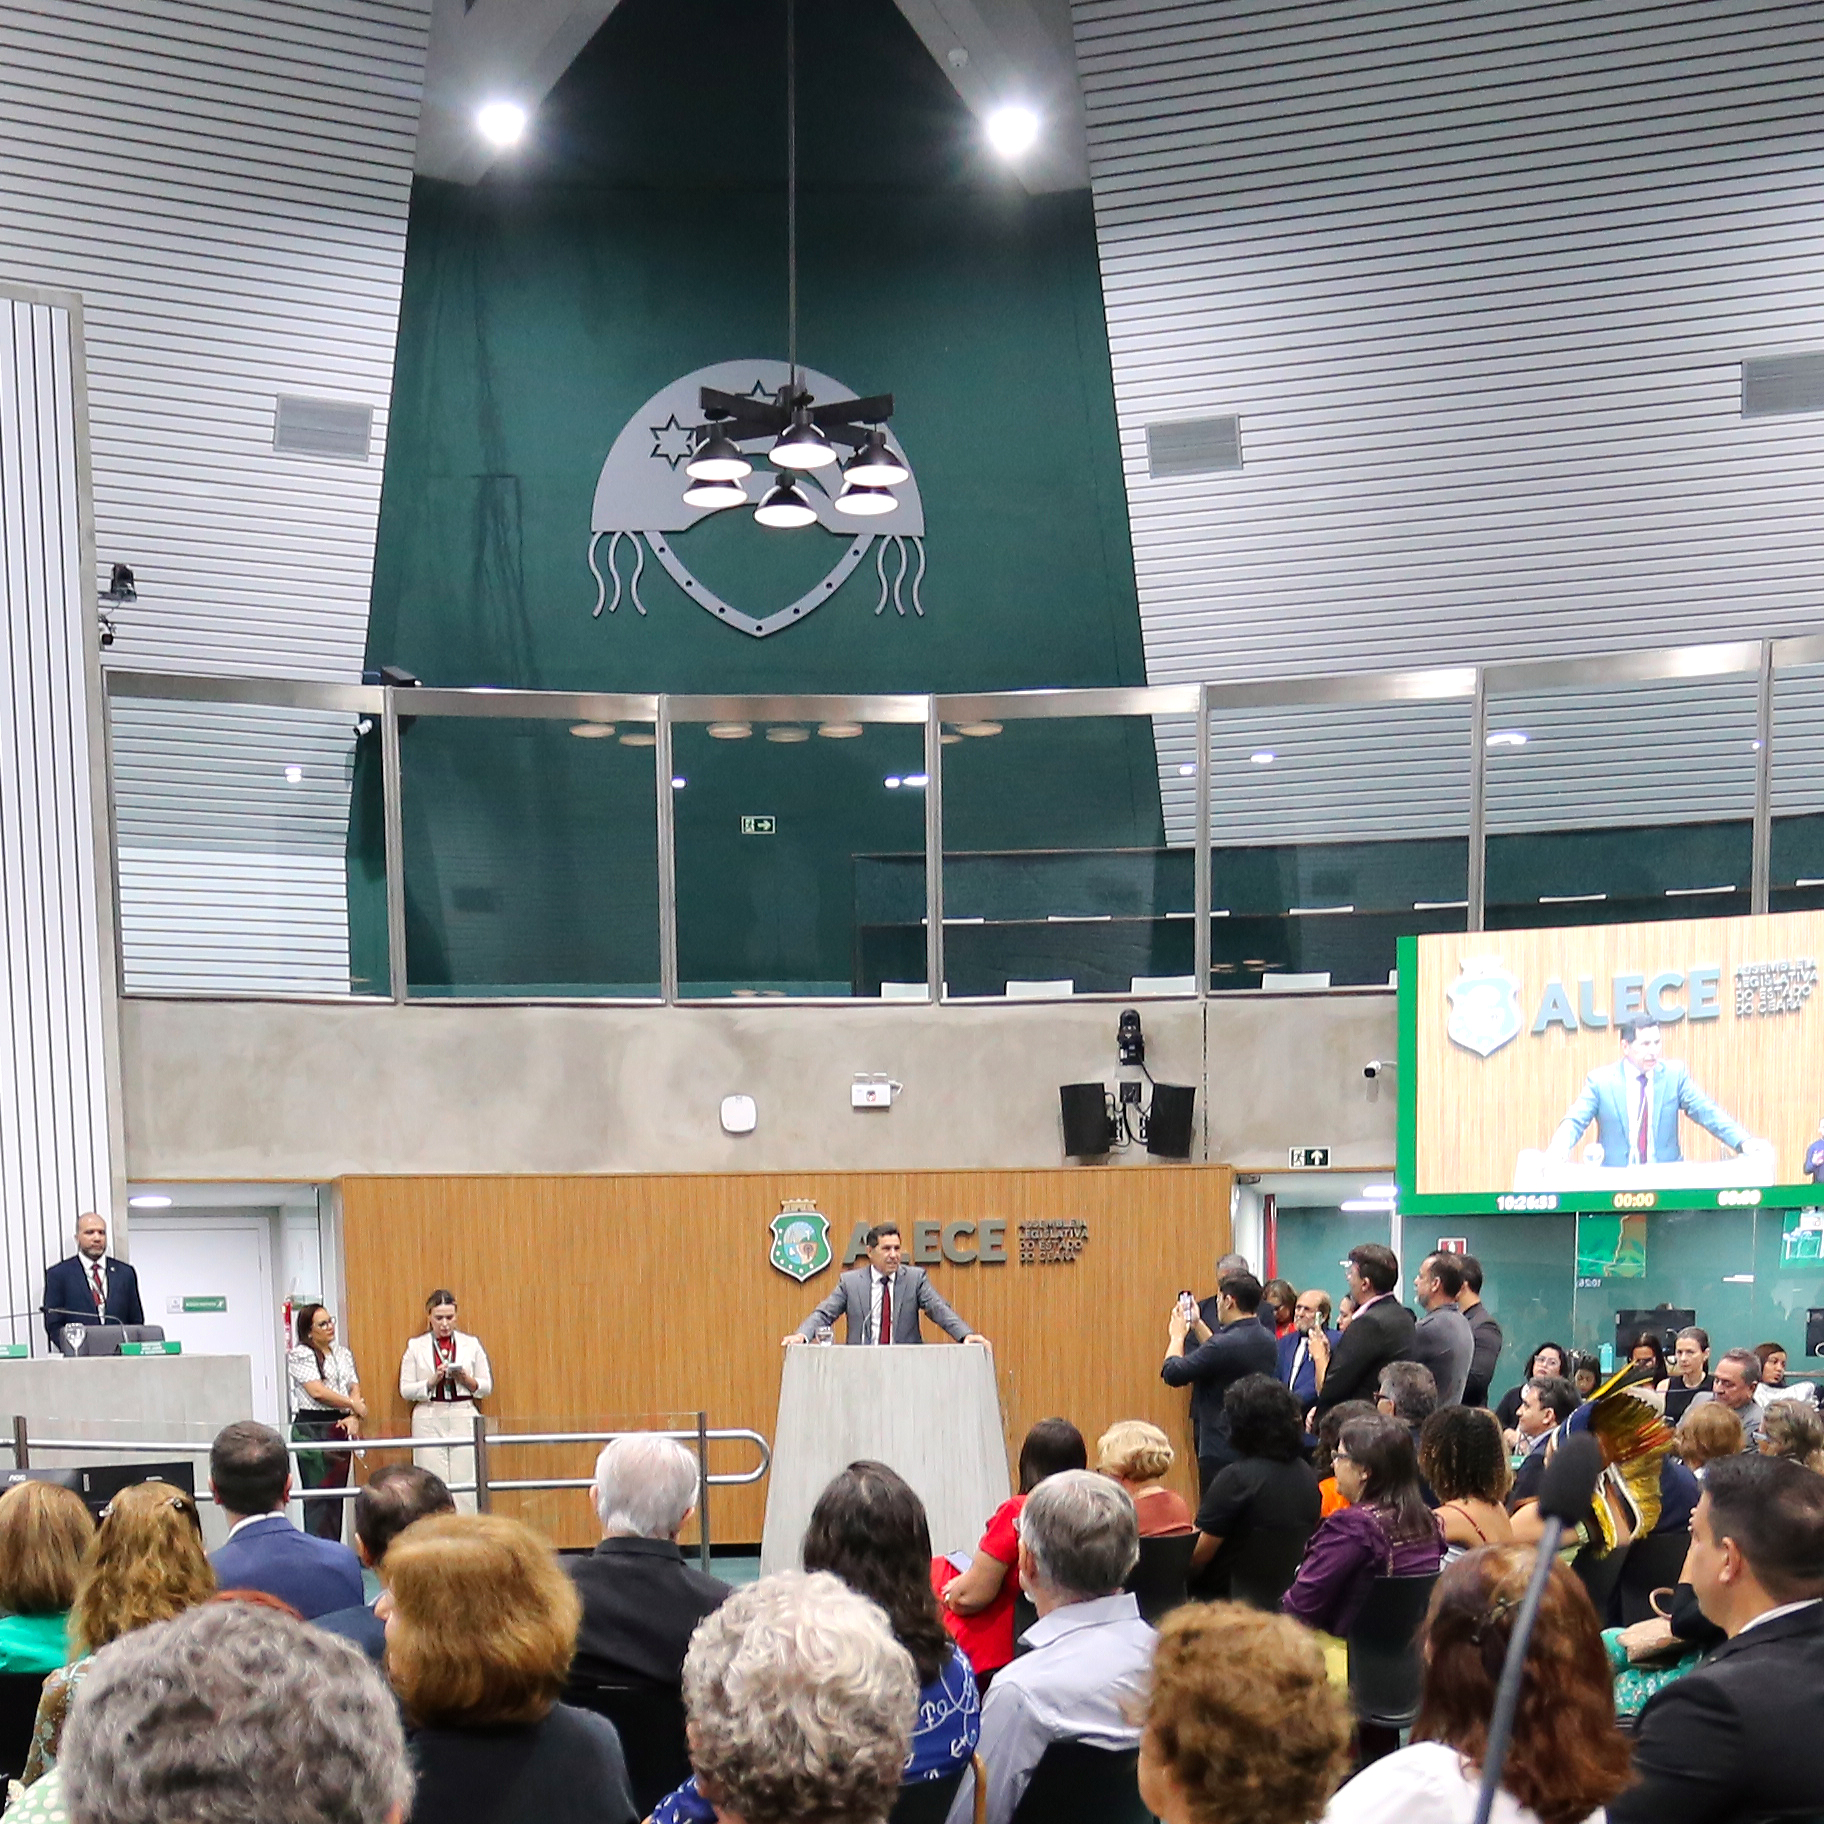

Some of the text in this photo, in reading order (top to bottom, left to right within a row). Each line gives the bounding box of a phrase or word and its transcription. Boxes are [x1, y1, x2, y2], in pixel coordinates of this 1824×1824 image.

[1531, 968, 1721, 1034] ALECE
[1614, 1193, 1655, 1207] 00:00
[843, 1218, 1008, 1265] AECE
